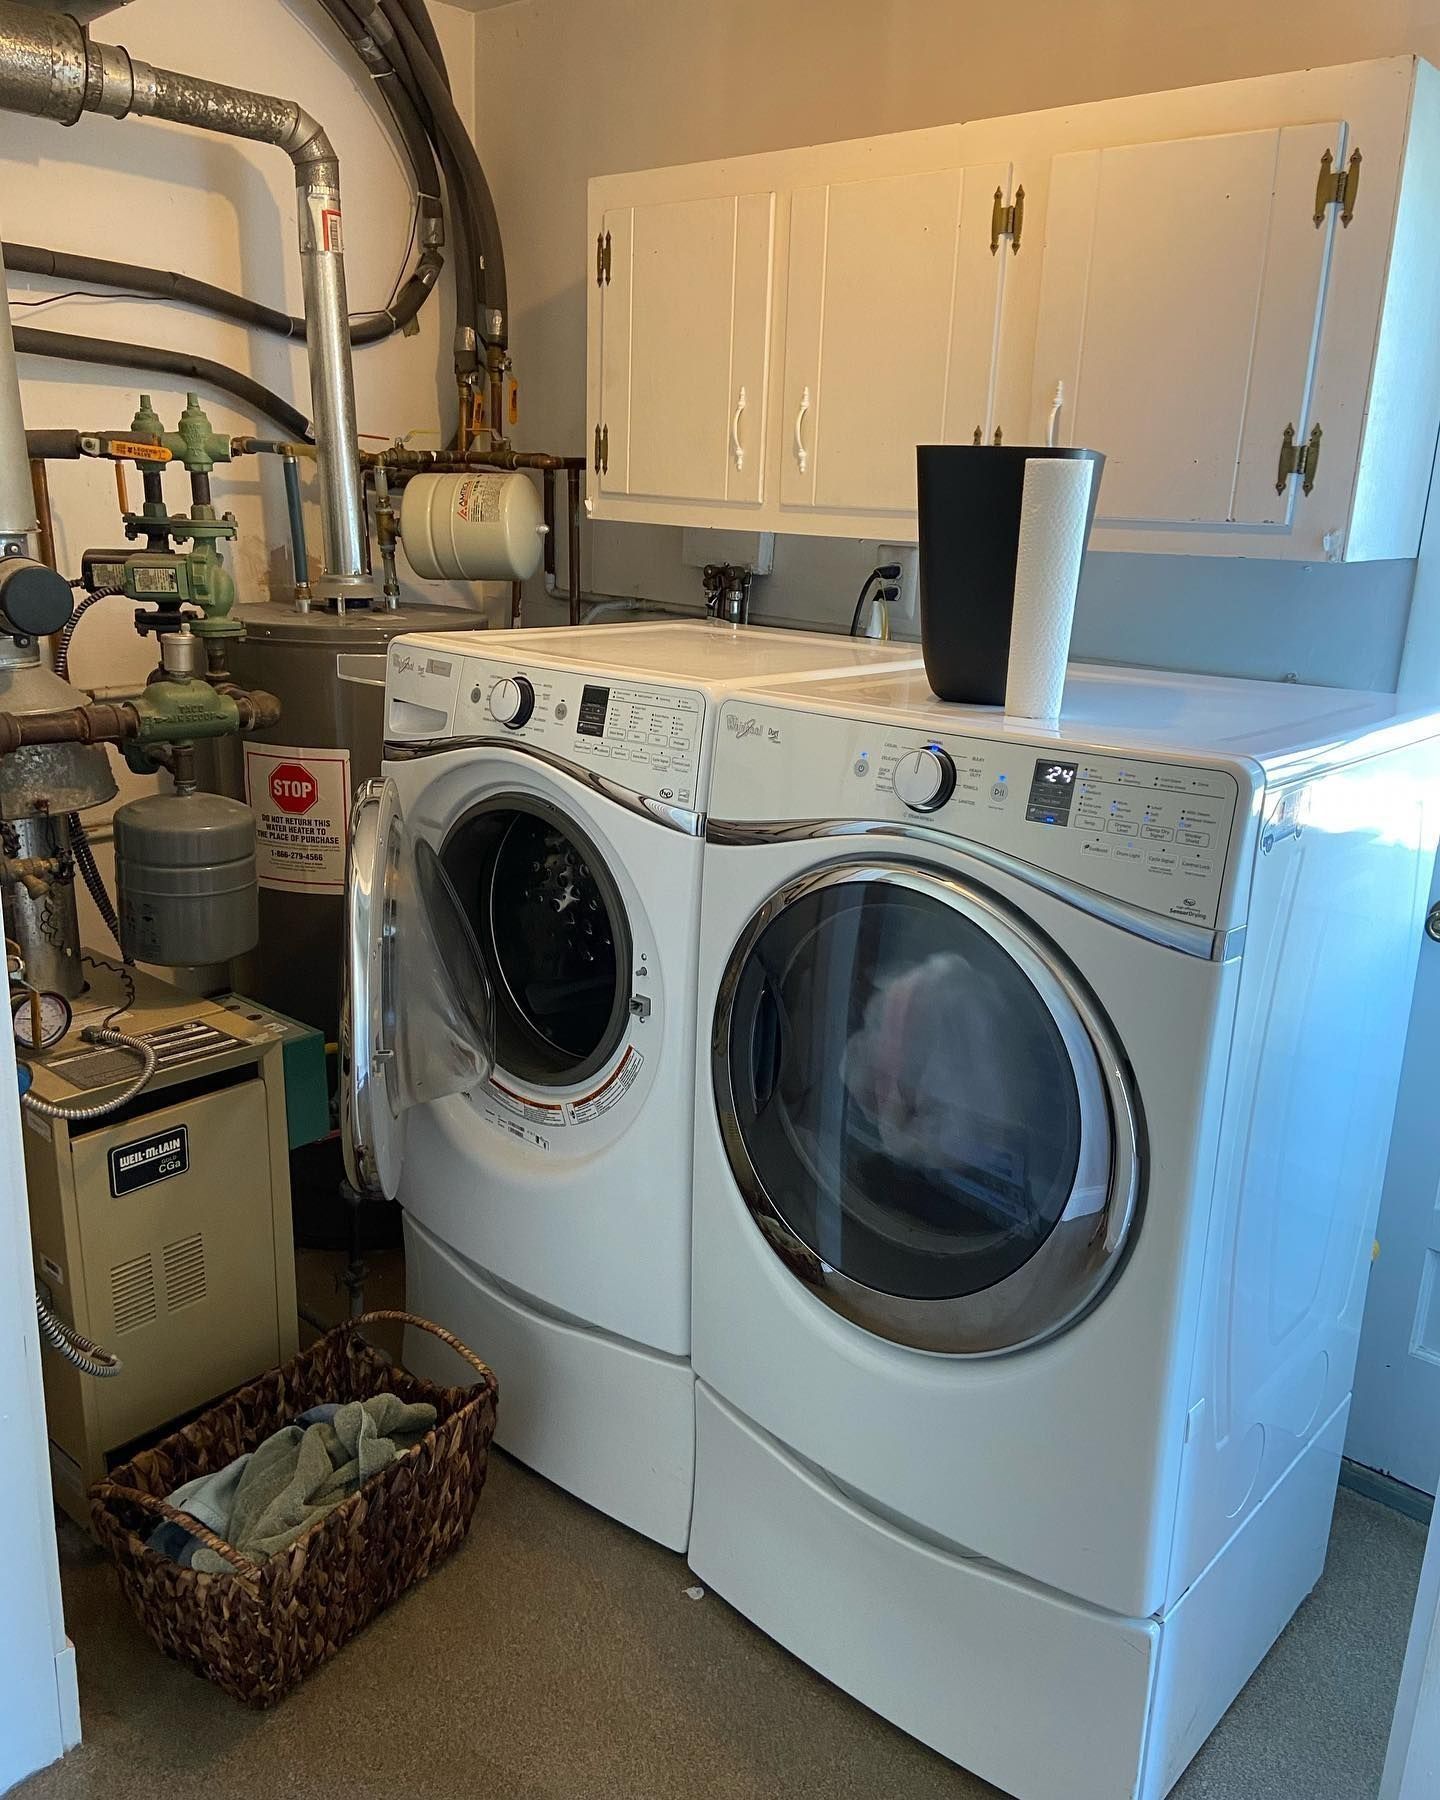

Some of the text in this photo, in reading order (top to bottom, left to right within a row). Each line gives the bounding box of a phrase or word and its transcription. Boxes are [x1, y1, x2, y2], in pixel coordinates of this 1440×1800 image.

[273, 779, 312, 798] STOP
[261, 814, 330, 827] DO NOT RETURN THIS
[266, 823, 326, 836] WATER HEATER TO
[257, 830, 268, 838] THE
[269, 832, 288, 841] PLACE
[301, 836, 339, 844] PURCHASE
[271, 850, 323, 861] 1-866-279-4566
[161, 1155, 176, 1164] GOLD
[159, 1160, 181, 1173] CGa
